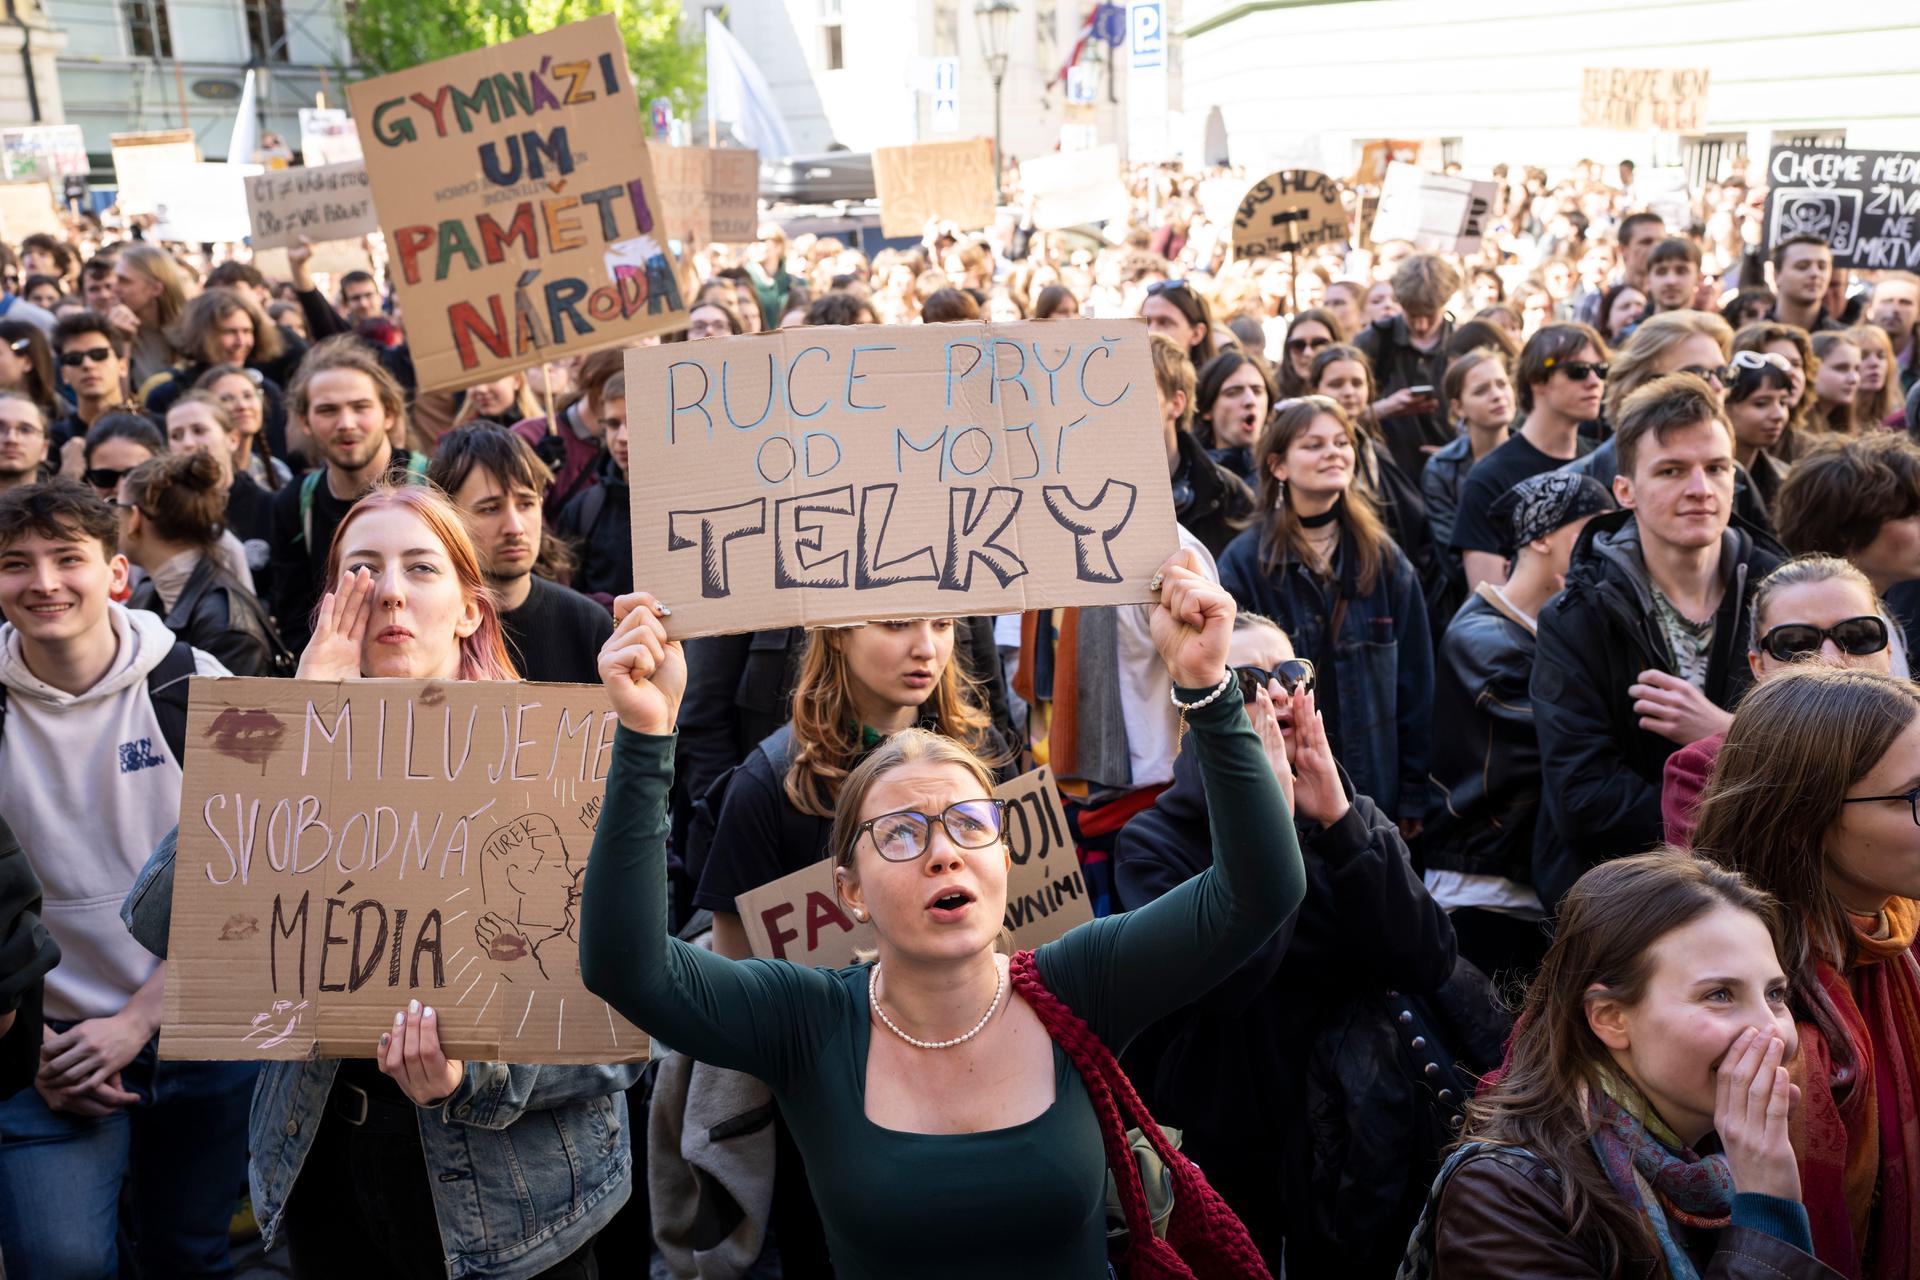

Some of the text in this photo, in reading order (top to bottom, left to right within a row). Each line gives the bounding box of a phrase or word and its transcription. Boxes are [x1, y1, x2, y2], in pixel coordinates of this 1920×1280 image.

[372, 53, 619, 147] GYMNÁZI
[478, 126, 575, 186] UM
[1772, 150, 1920, 184] CHCEME MÉDI
[394, 178, 655, 286] PAMĚTI
[1881, 217, 1915, 238] NE
[448, 253, 684, 371] NÁRODA
[667, 337, 1131, 445] RUCE PRYČ
[755, 414, 1089, 486] OD MOJÍ
[668, 479, 1137, 598] TELKY
[300, 698, 617, 783] MILUJEME
[203, 793, 496, 885] SVOBODNÁ
[487, 820, 536, 861] TUREK
[1006, 770, 1063, 865] OJÍ
[270, 880, 446, 999] MÉDIA
[761, 890, 854, 960] FA
